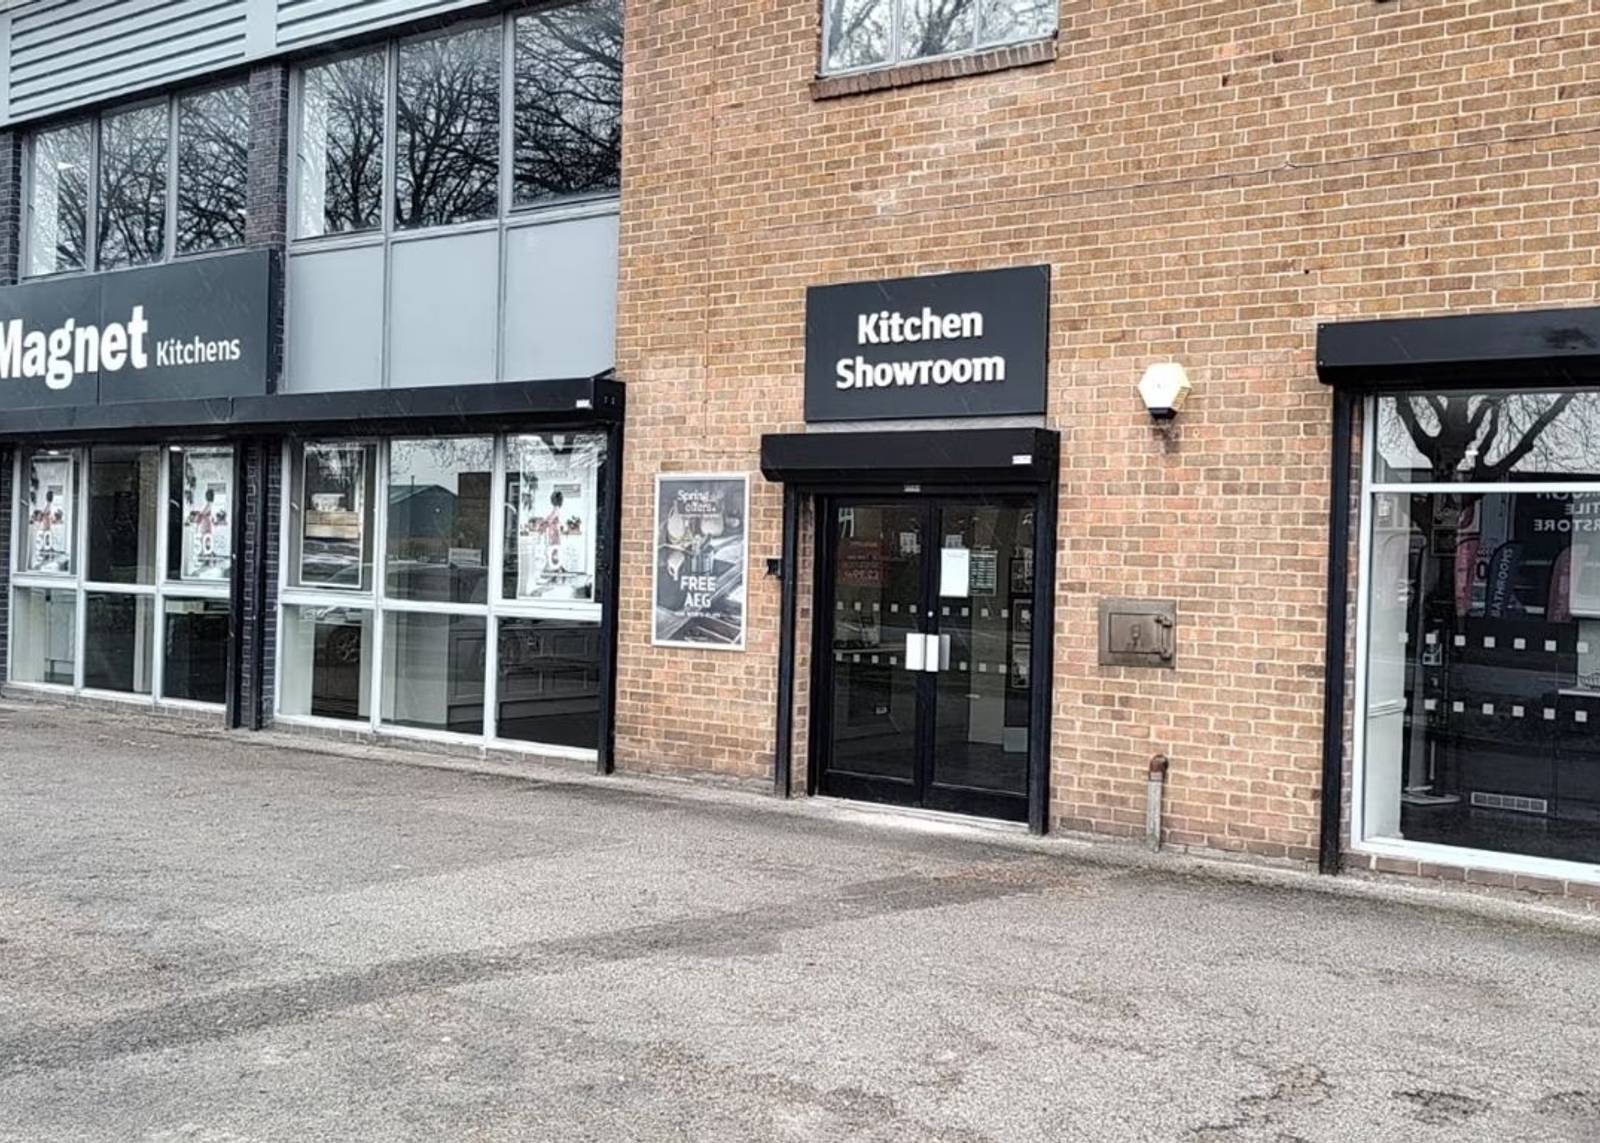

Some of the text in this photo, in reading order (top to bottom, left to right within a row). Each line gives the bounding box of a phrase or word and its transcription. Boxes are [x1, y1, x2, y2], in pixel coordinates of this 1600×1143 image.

[858, 306, 984, 344] Kitchen
[0, 305, 241, 390] Magnet Kitchens
[836, 355, 1006, 390] Showroom
[680, 575, 716, 592] FREE
[684, 592, 712, 608] AEG
